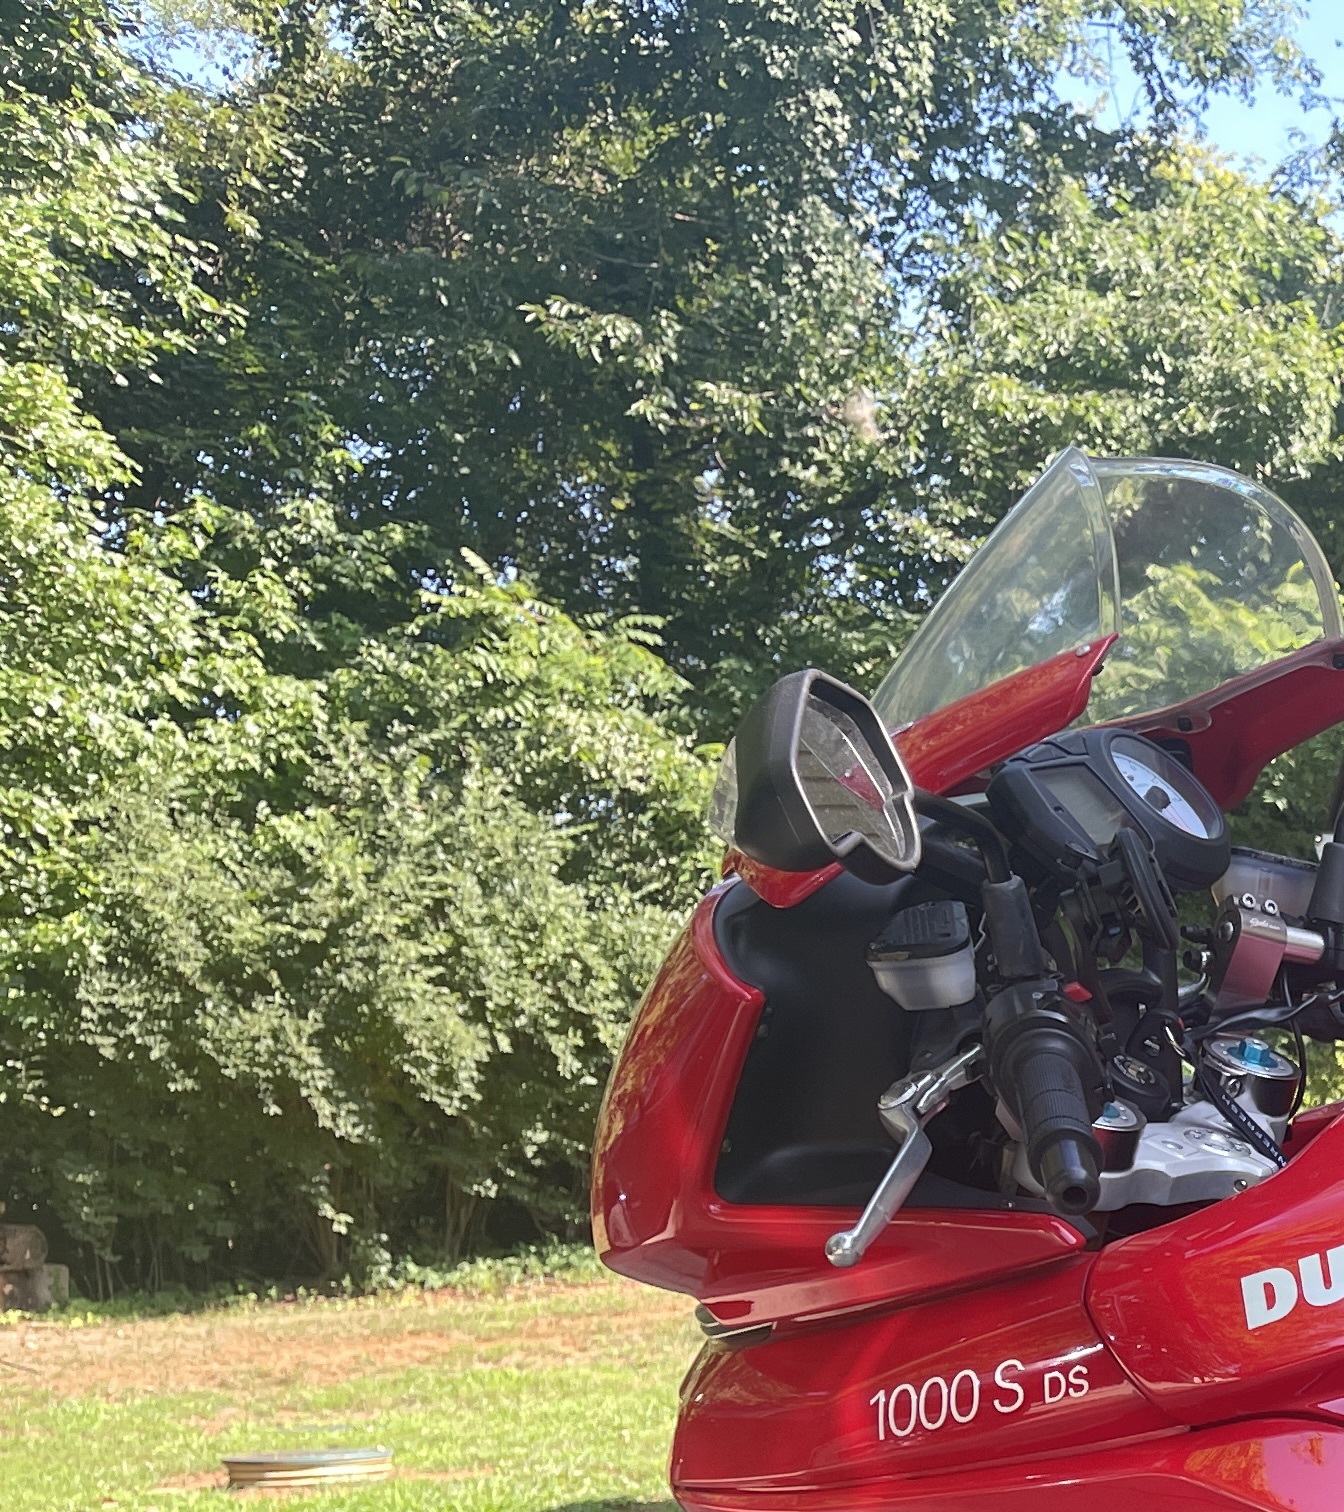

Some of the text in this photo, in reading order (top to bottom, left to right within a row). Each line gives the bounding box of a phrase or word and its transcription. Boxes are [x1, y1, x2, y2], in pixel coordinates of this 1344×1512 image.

[869, 1359, 1089, 1440] 1000 S DS
